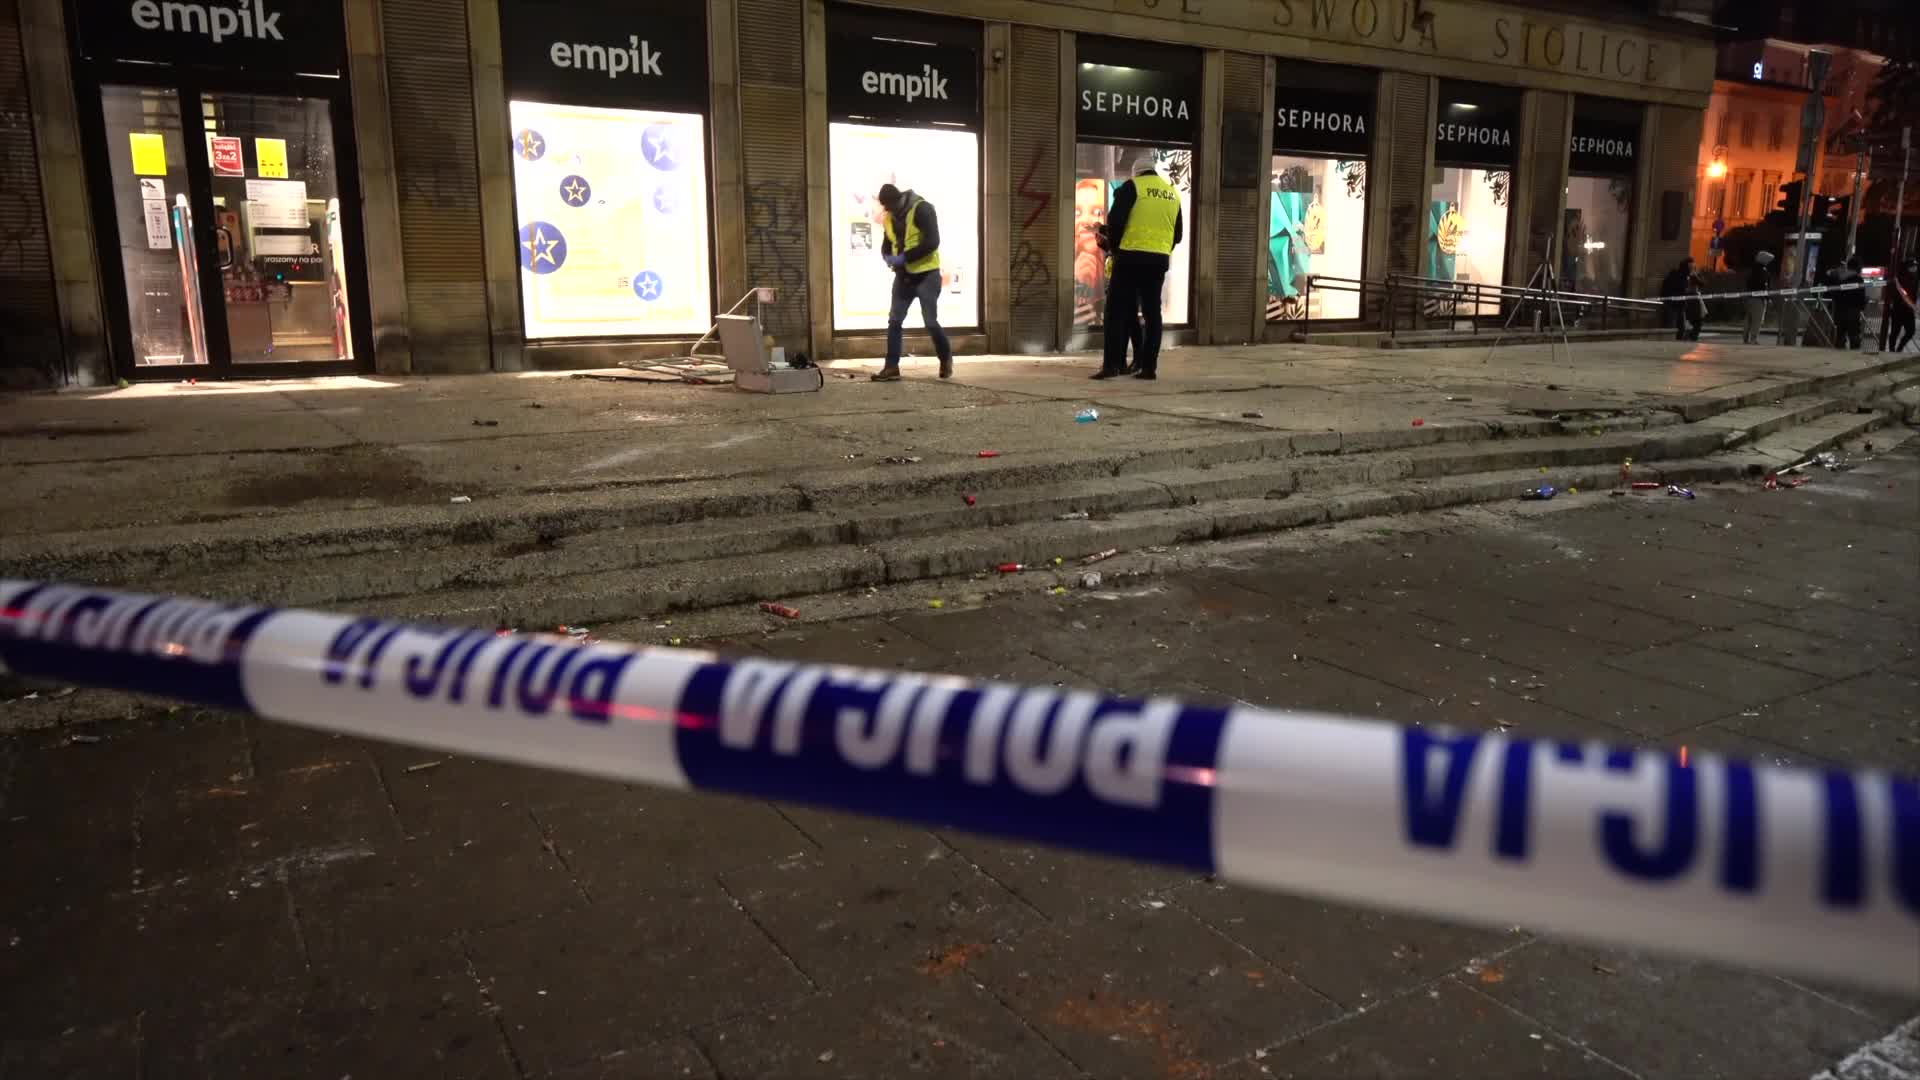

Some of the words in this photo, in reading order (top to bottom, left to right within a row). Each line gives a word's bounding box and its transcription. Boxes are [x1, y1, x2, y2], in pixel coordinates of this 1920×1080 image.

[131, 0, 284, 43] empik
[550, 35, 663, 79] empik
[862, 64, 948, 102] empik
[1081, 90, 1190, 121] SEPHORA
[1277, 108, 1366, 135] SEPHORA
[1437, 123, 1511, 147] SEPHORA
[1570, 136, 1634, 158] SEPHORA
